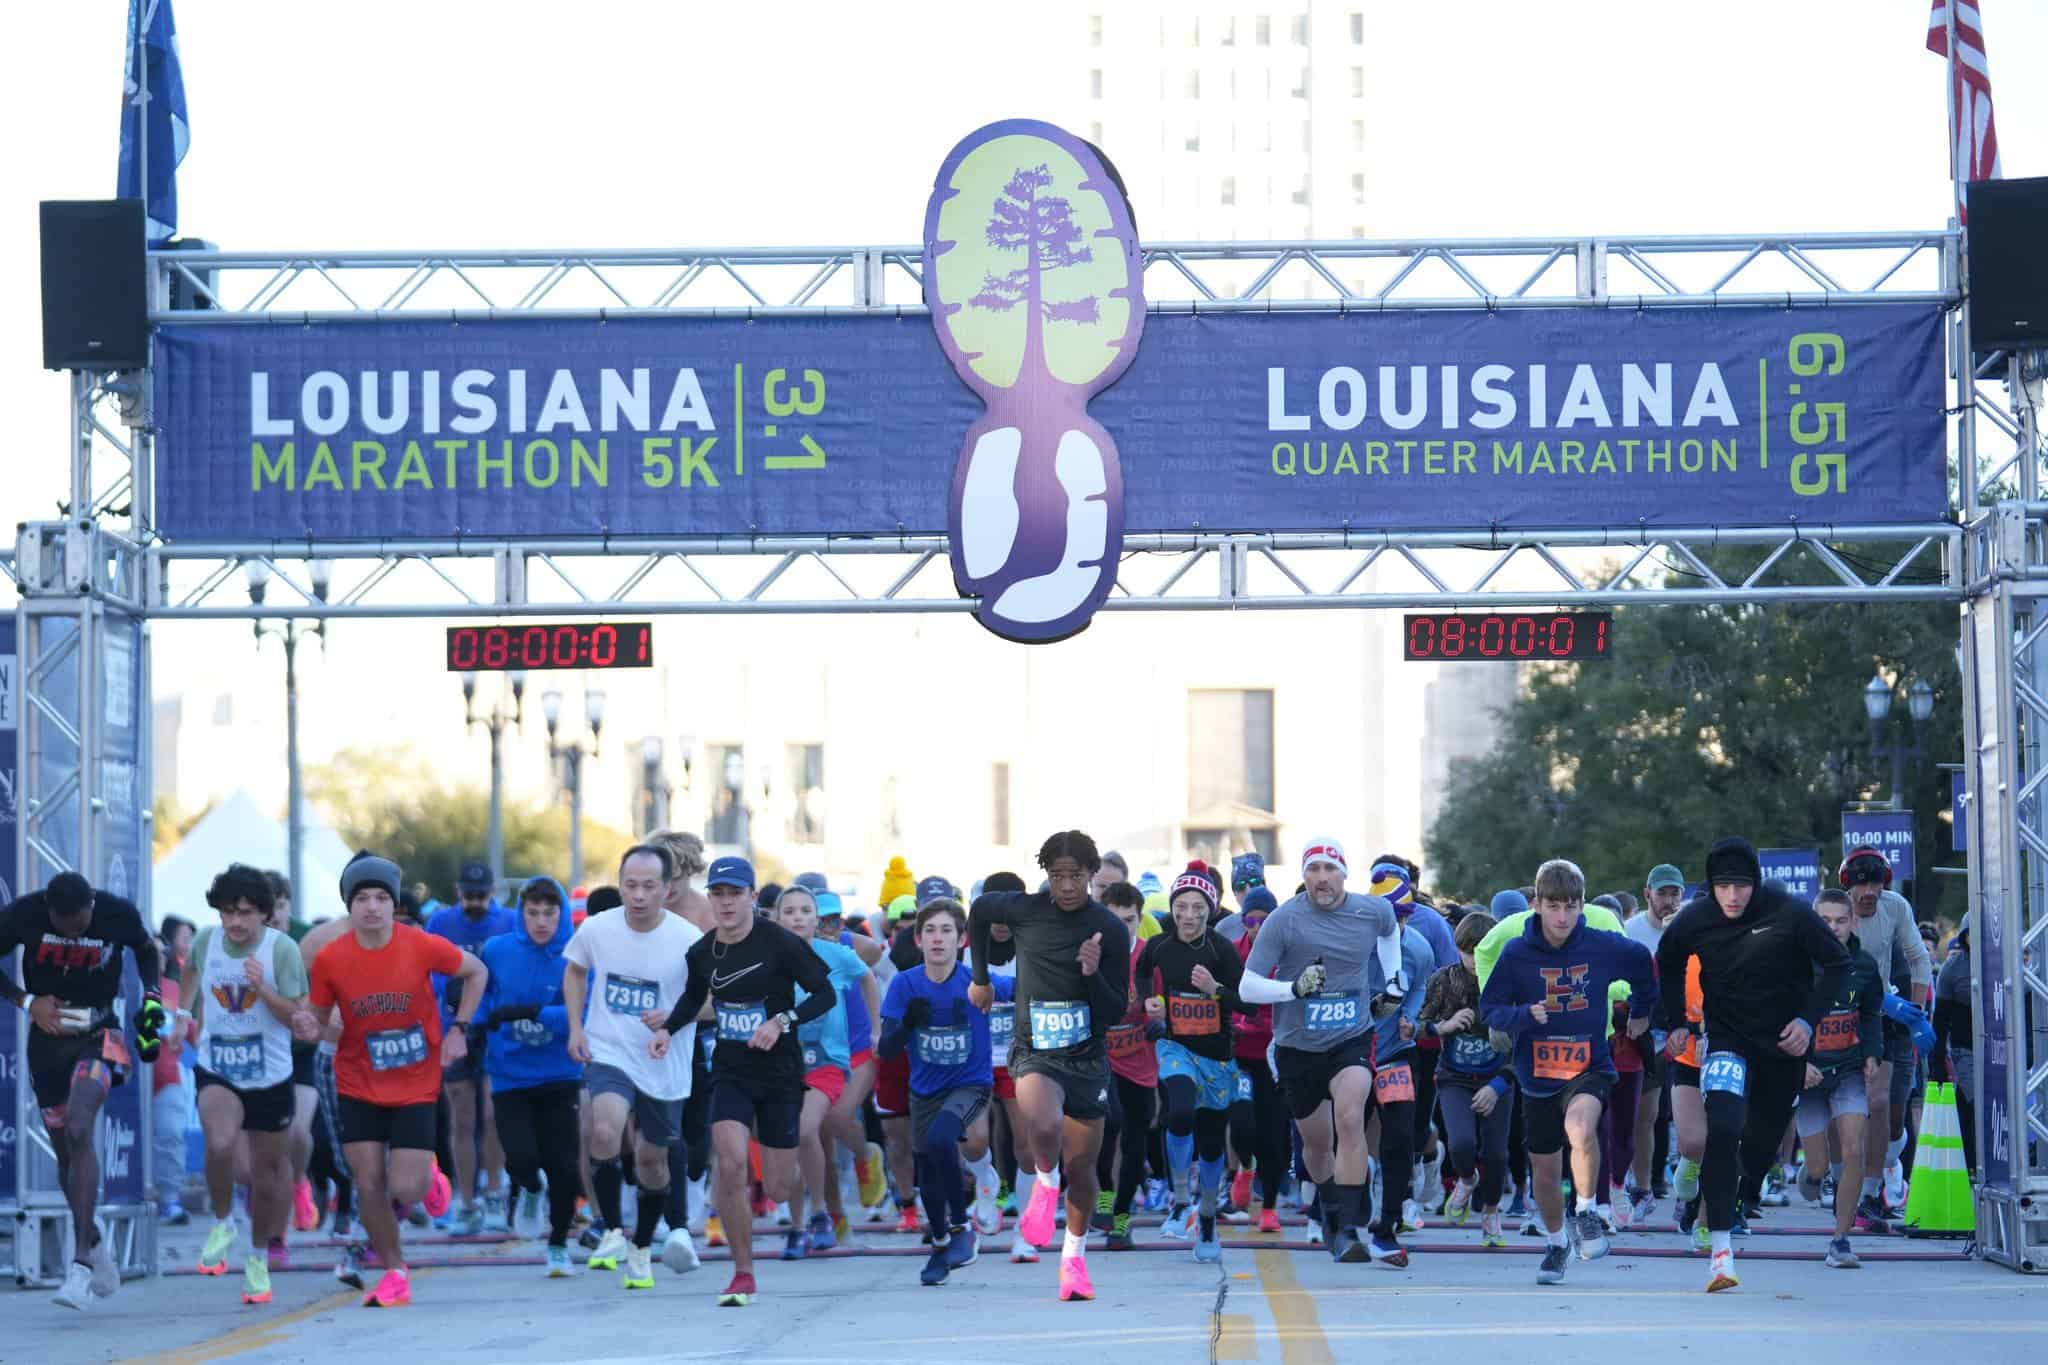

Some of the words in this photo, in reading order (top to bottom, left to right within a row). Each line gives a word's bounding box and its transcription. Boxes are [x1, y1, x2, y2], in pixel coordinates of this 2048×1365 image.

[251, 367, 716, 437] LOUISIANA
[1267, 362, 1740, 431] LOUISIANA
[763, 368, 827, 470] 3.1
[1787, 332, 1848, 497] 6.55
[251, 438, 609, 491] MARATHON
[642, 437, 720, 488] 5K
[1271, 440, 1478, 476] QUARTER
[1492, 438, 1738, 475] MARATHON
[452, 625, 648, 668] 08:00:01
[1409, 617, 1605, 656] 08:00:01
[1844, 831, 1882, 845] 10:00
[1886, 831, 1913, 845] MIN
[1794, 865, 1818, 879] MIN
[607, 984, 657, 1008] 7316
[1033, 1011, 1085, 1032] 7901
[1172, 1002, 1216, 1018] 6008
[1308, 1001, 1356, 1021] 7283
[990, 1016, 1014, 1033] 85
[371, 1033, 423, 1057] 7018
[919, 1033, 966, 1051] 7051
[213, 1045, 260, 1065] 7034
[1537, 1046, 1586, 1064] 6174
